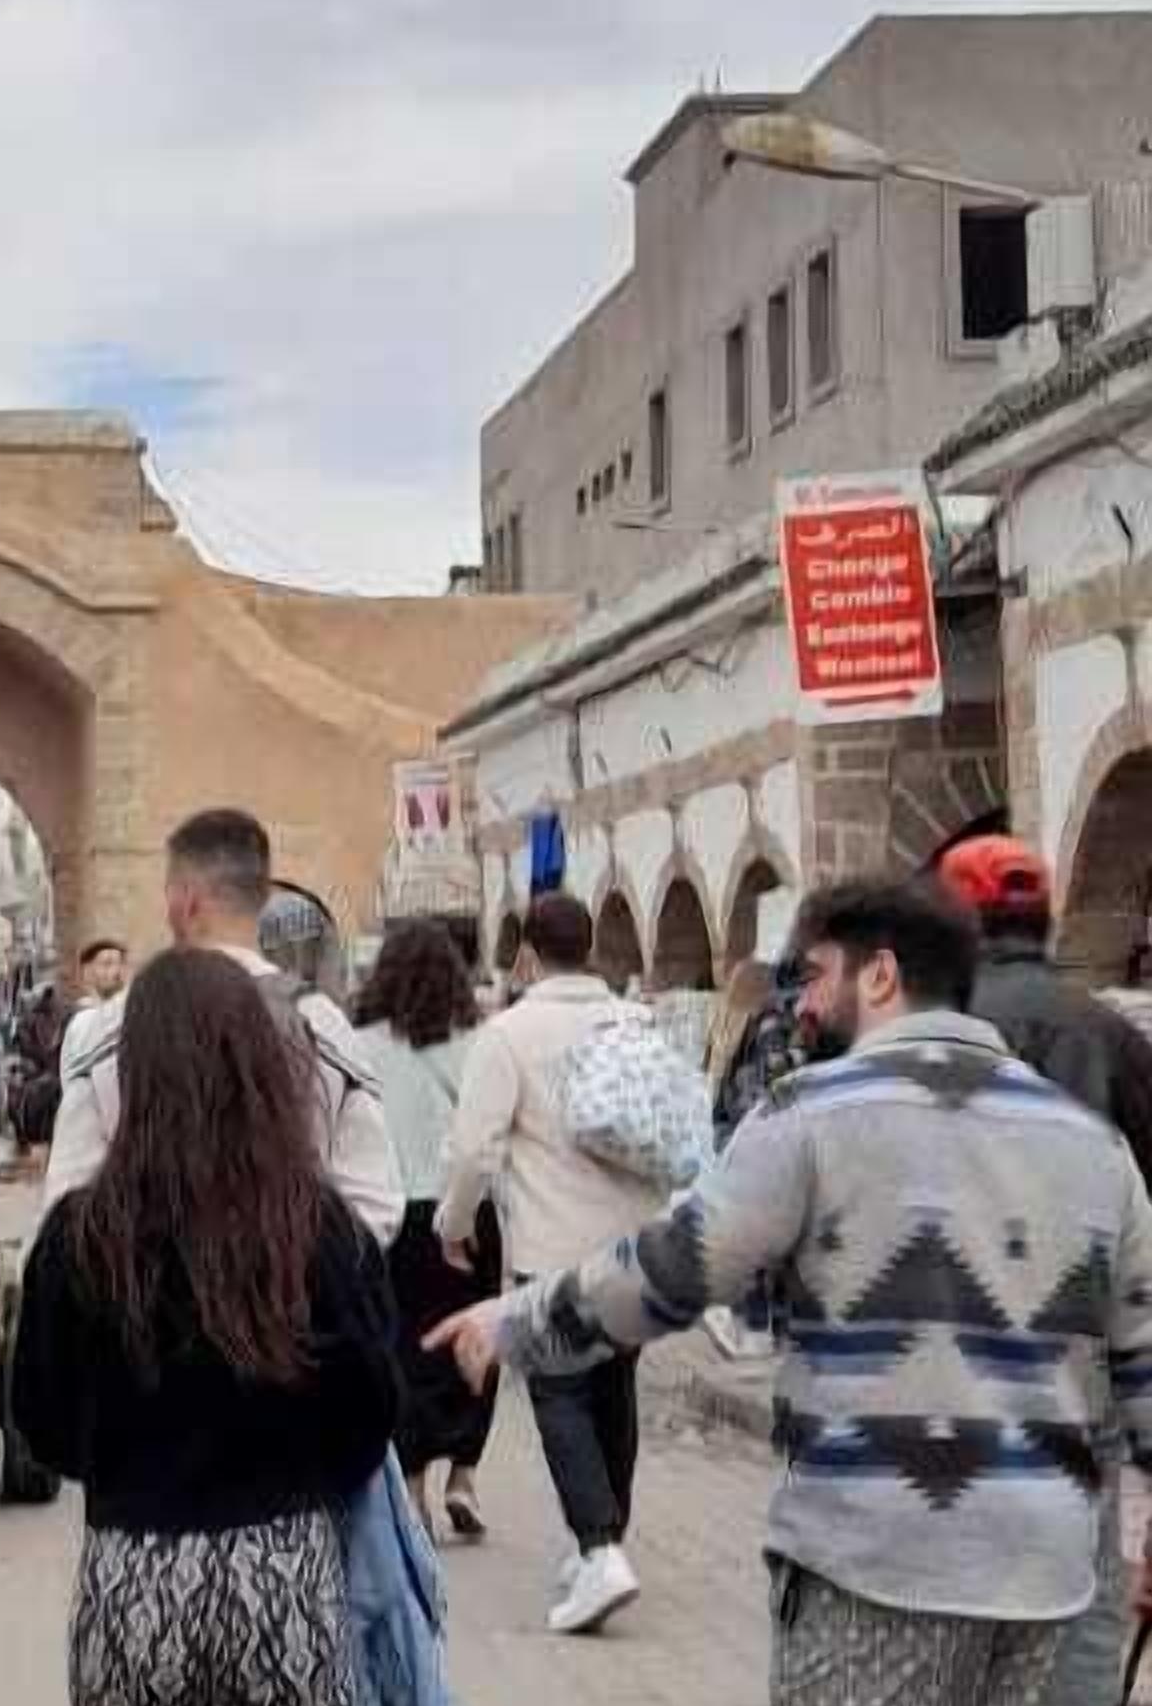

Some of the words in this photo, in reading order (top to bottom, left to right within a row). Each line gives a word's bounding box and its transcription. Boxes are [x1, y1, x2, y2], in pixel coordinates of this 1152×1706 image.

[796, 514, 910, 551] الصرف
[807, 555, 909, 581] Change
[810, 580, 912, 611] Cambio
[806, 620, 923, 647] Exchange
